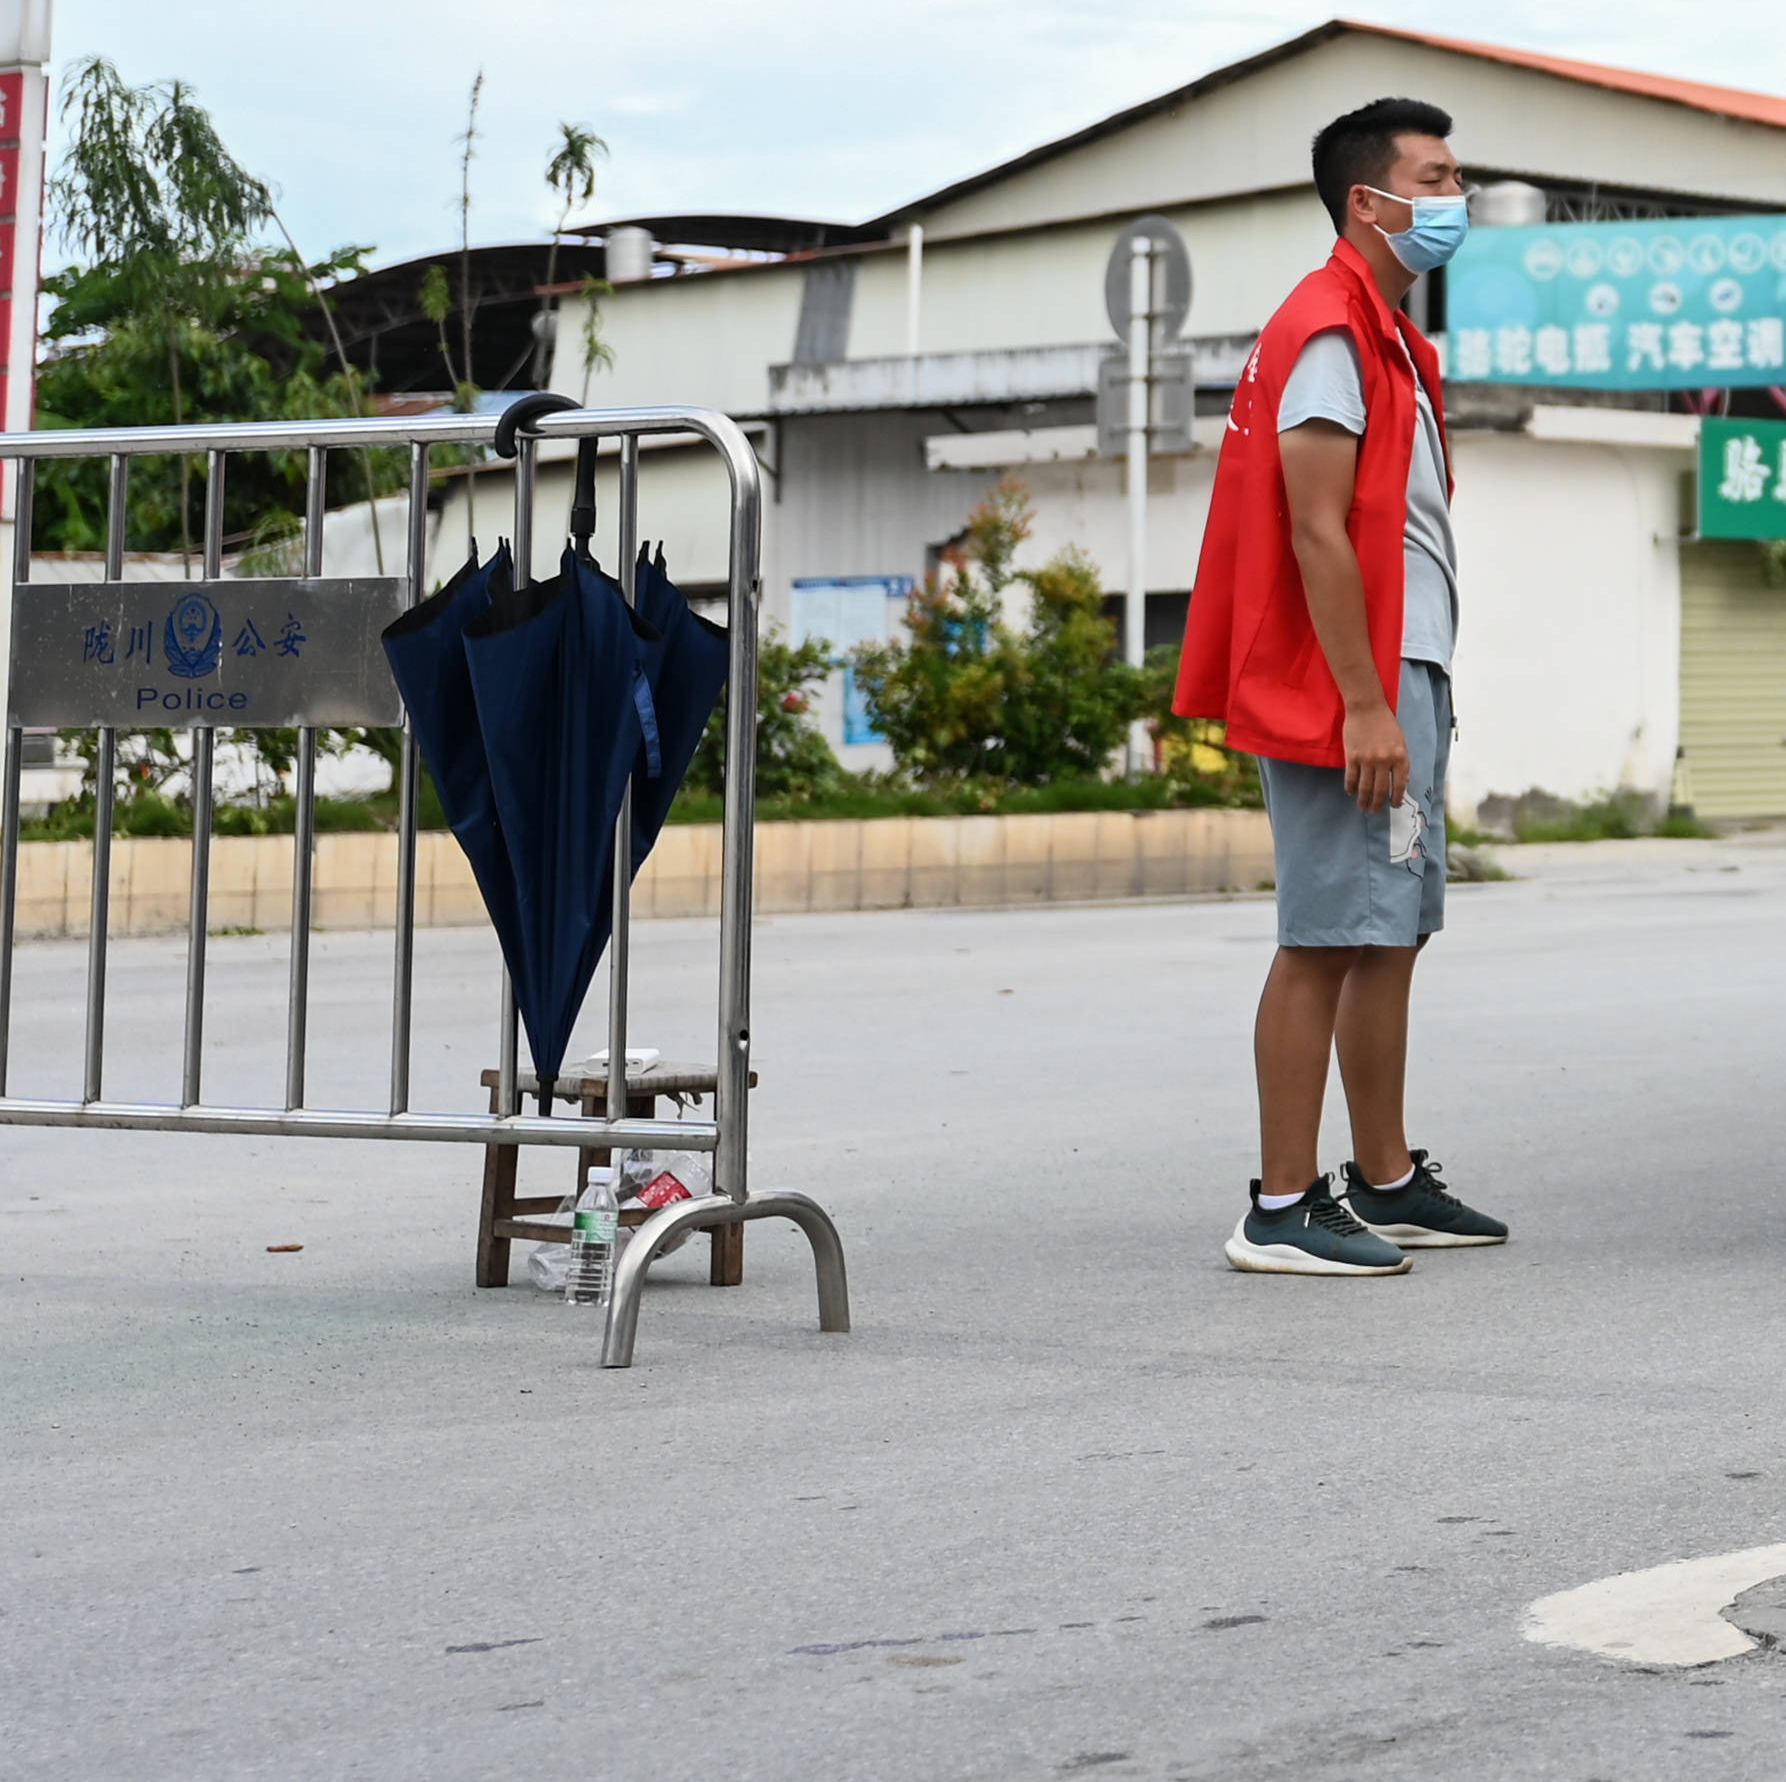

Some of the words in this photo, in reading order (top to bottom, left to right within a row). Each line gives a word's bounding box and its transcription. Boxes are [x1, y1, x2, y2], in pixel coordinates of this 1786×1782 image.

[83, 620, 153, 665] 陇川
[231, 612, 307, 658] 公安
[136, 687, 248, 710] Police
